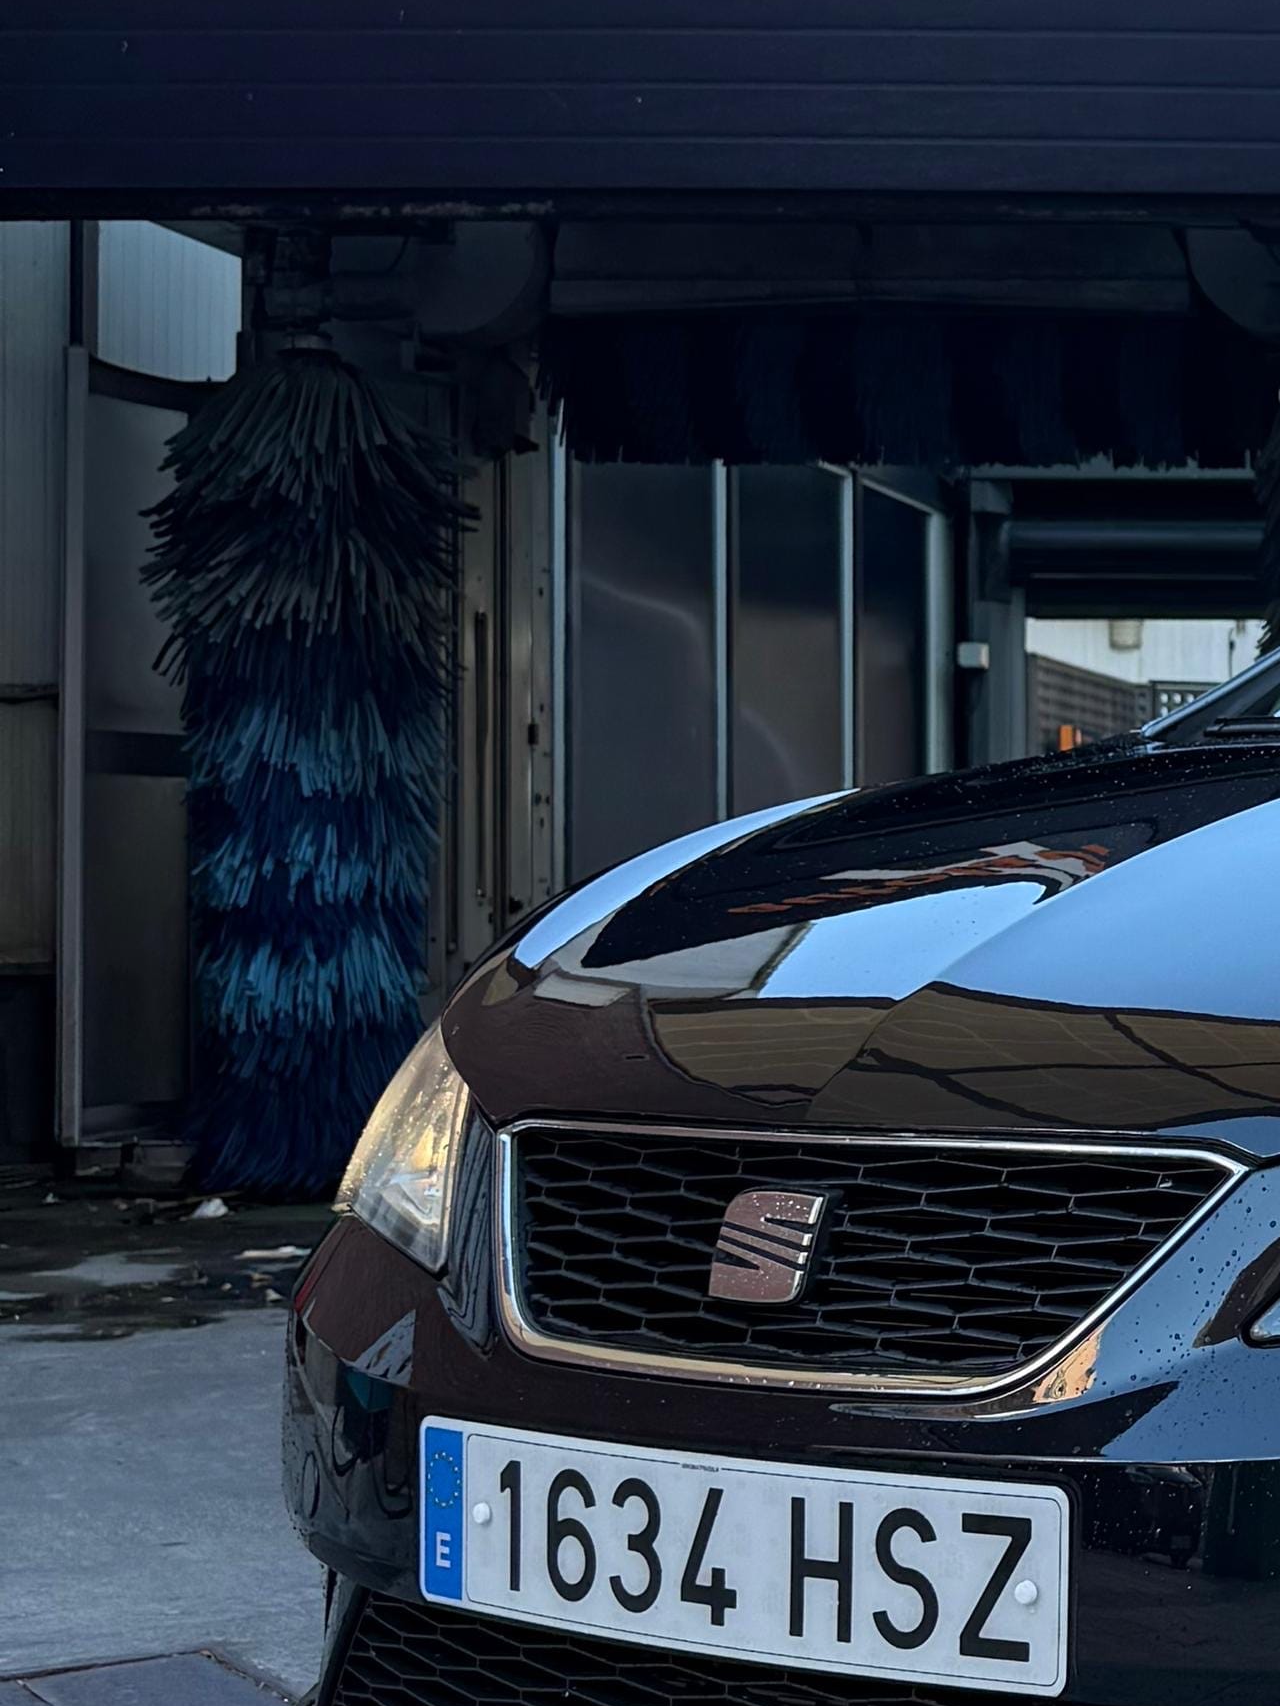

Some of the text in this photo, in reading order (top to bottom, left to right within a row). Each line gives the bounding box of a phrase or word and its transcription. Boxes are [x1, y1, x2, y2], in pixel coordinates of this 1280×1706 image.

[434, 1531, 452, 1569] E
[499, 1459, 1033, 1663] 1634 HSZ
